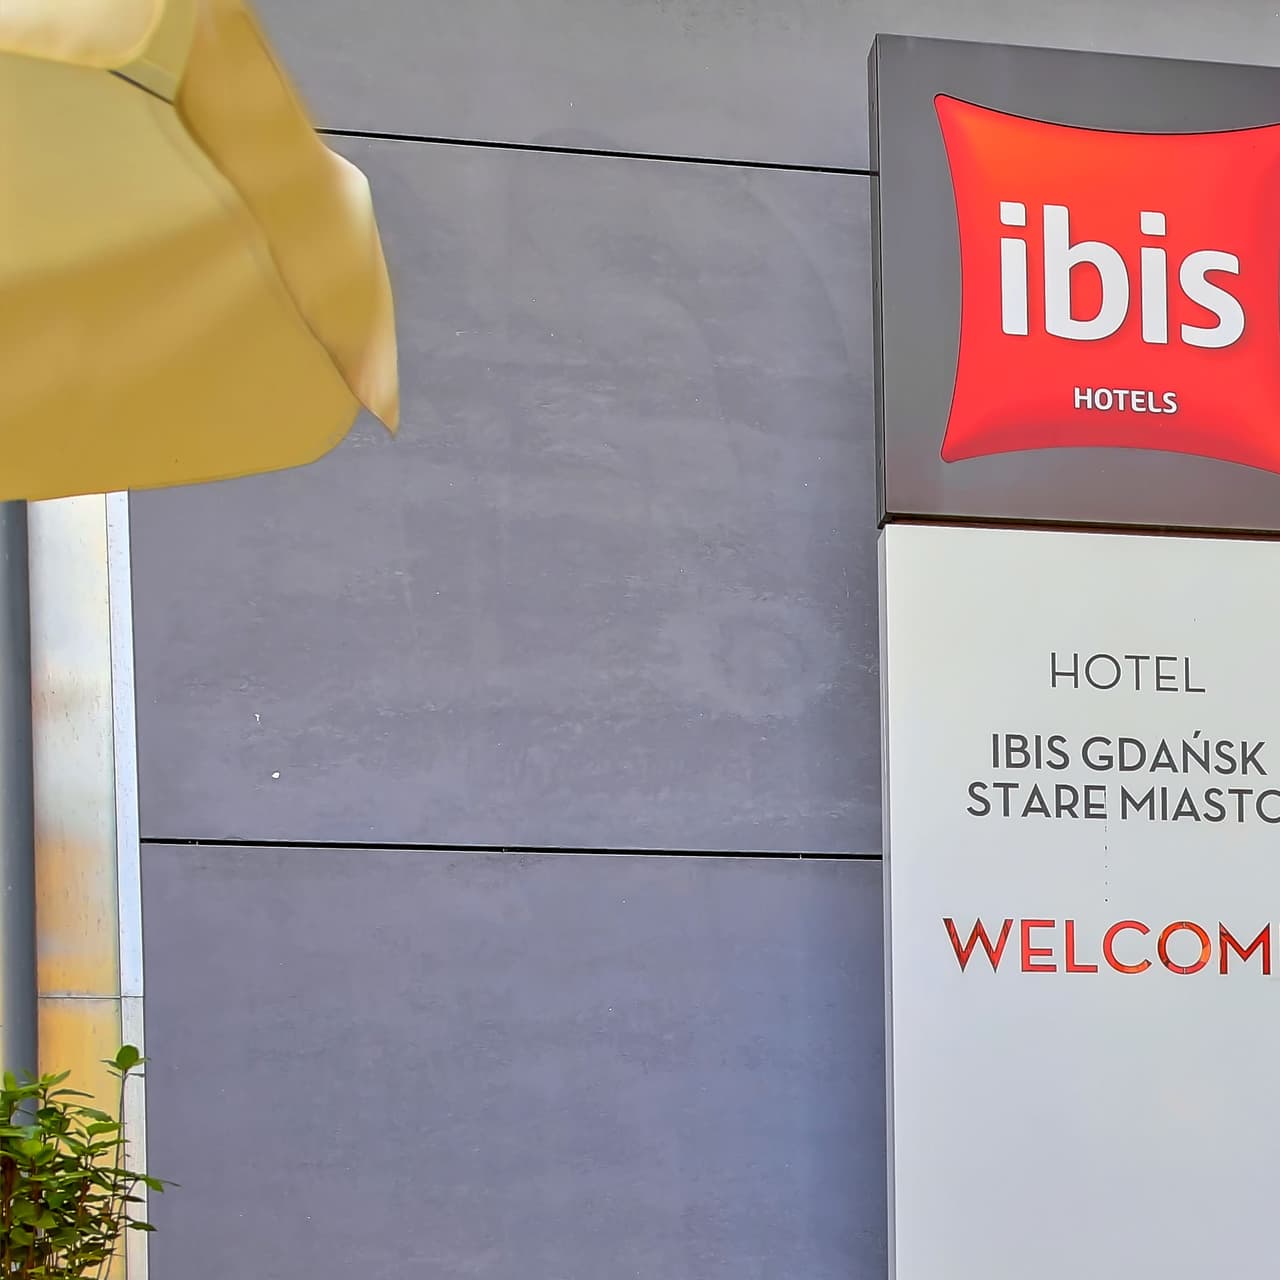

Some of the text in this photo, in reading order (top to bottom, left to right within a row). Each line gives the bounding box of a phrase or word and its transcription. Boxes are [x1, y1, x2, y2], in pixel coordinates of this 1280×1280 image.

[999, 201, 1246, 349] ibis
[1073, 386, 1179, 415] HOTELS
[1050, 652, 1206, 693] HOTEL
[991, 730, 1268, 776] IBIS GDAŃSK
[966, 781, 1108, 820] STARE
